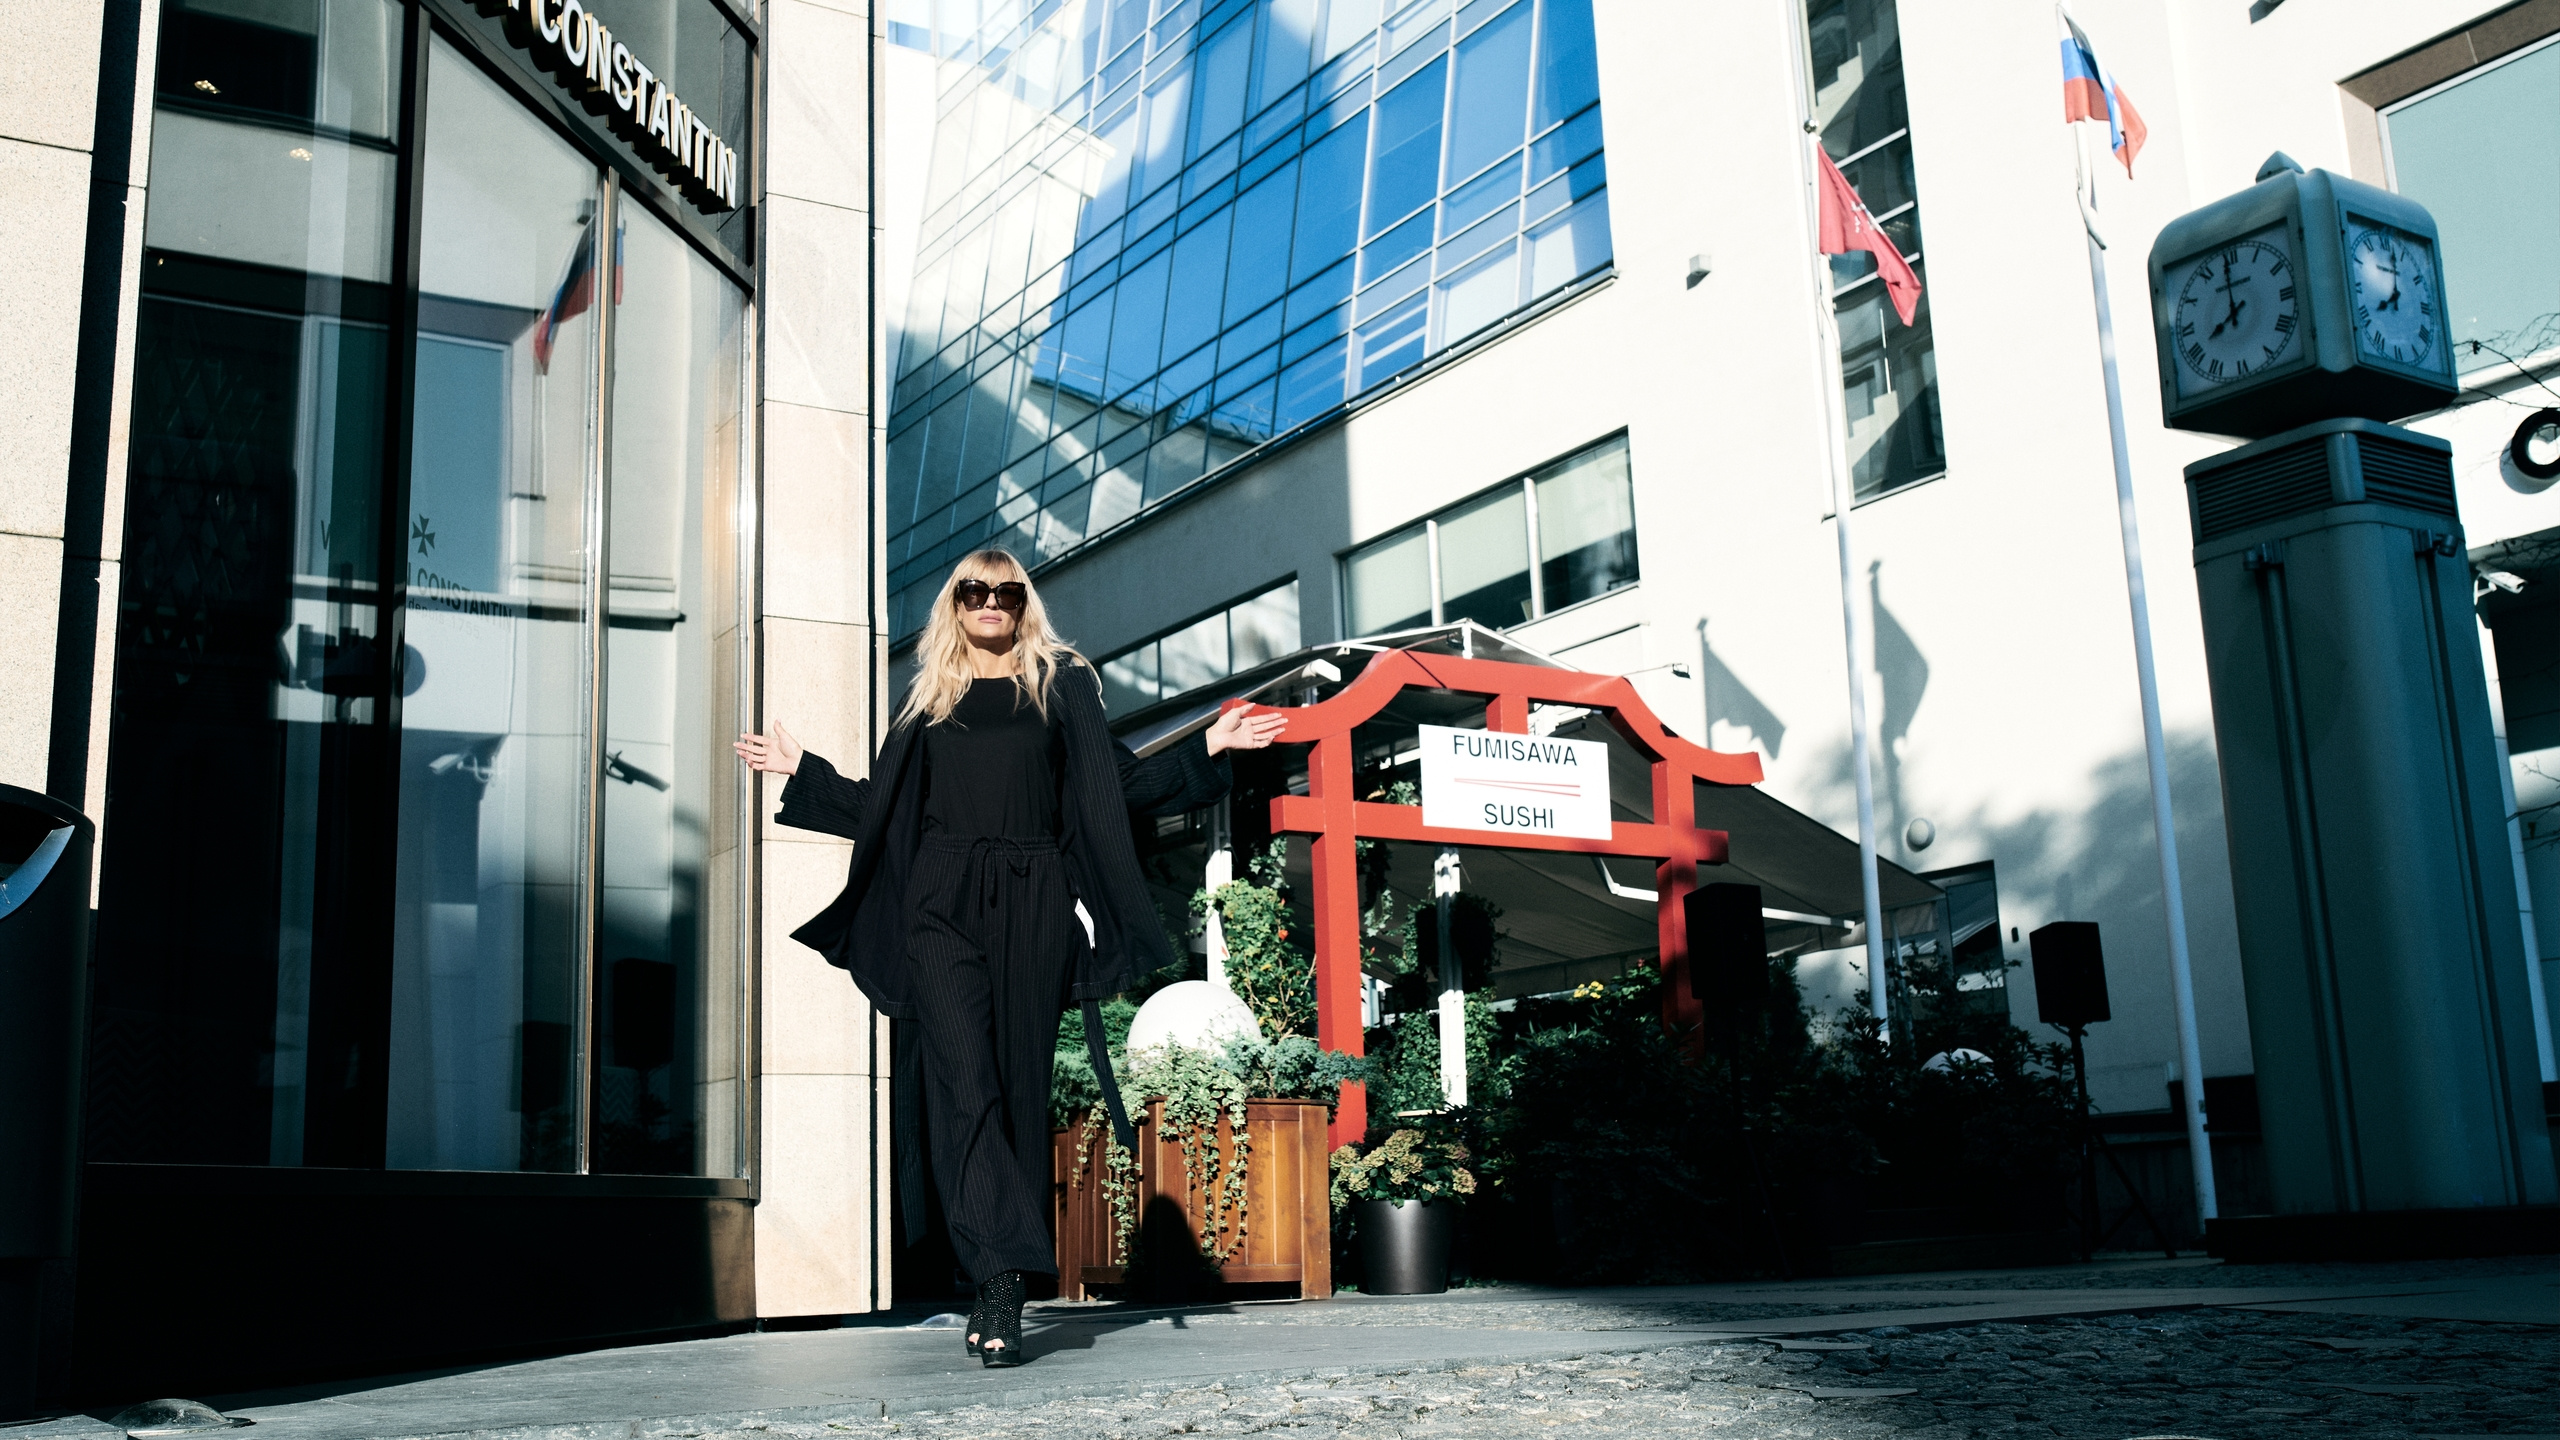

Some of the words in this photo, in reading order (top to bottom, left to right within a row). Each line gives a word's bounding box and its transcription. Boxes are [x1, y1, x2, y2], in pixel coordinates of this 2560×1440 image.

[417, 567, 512, 632] CONSTANTIN
[1453, 734, 1578, 767] FUMISAWA
[1484, 803, 1554, 829] SUSHI
